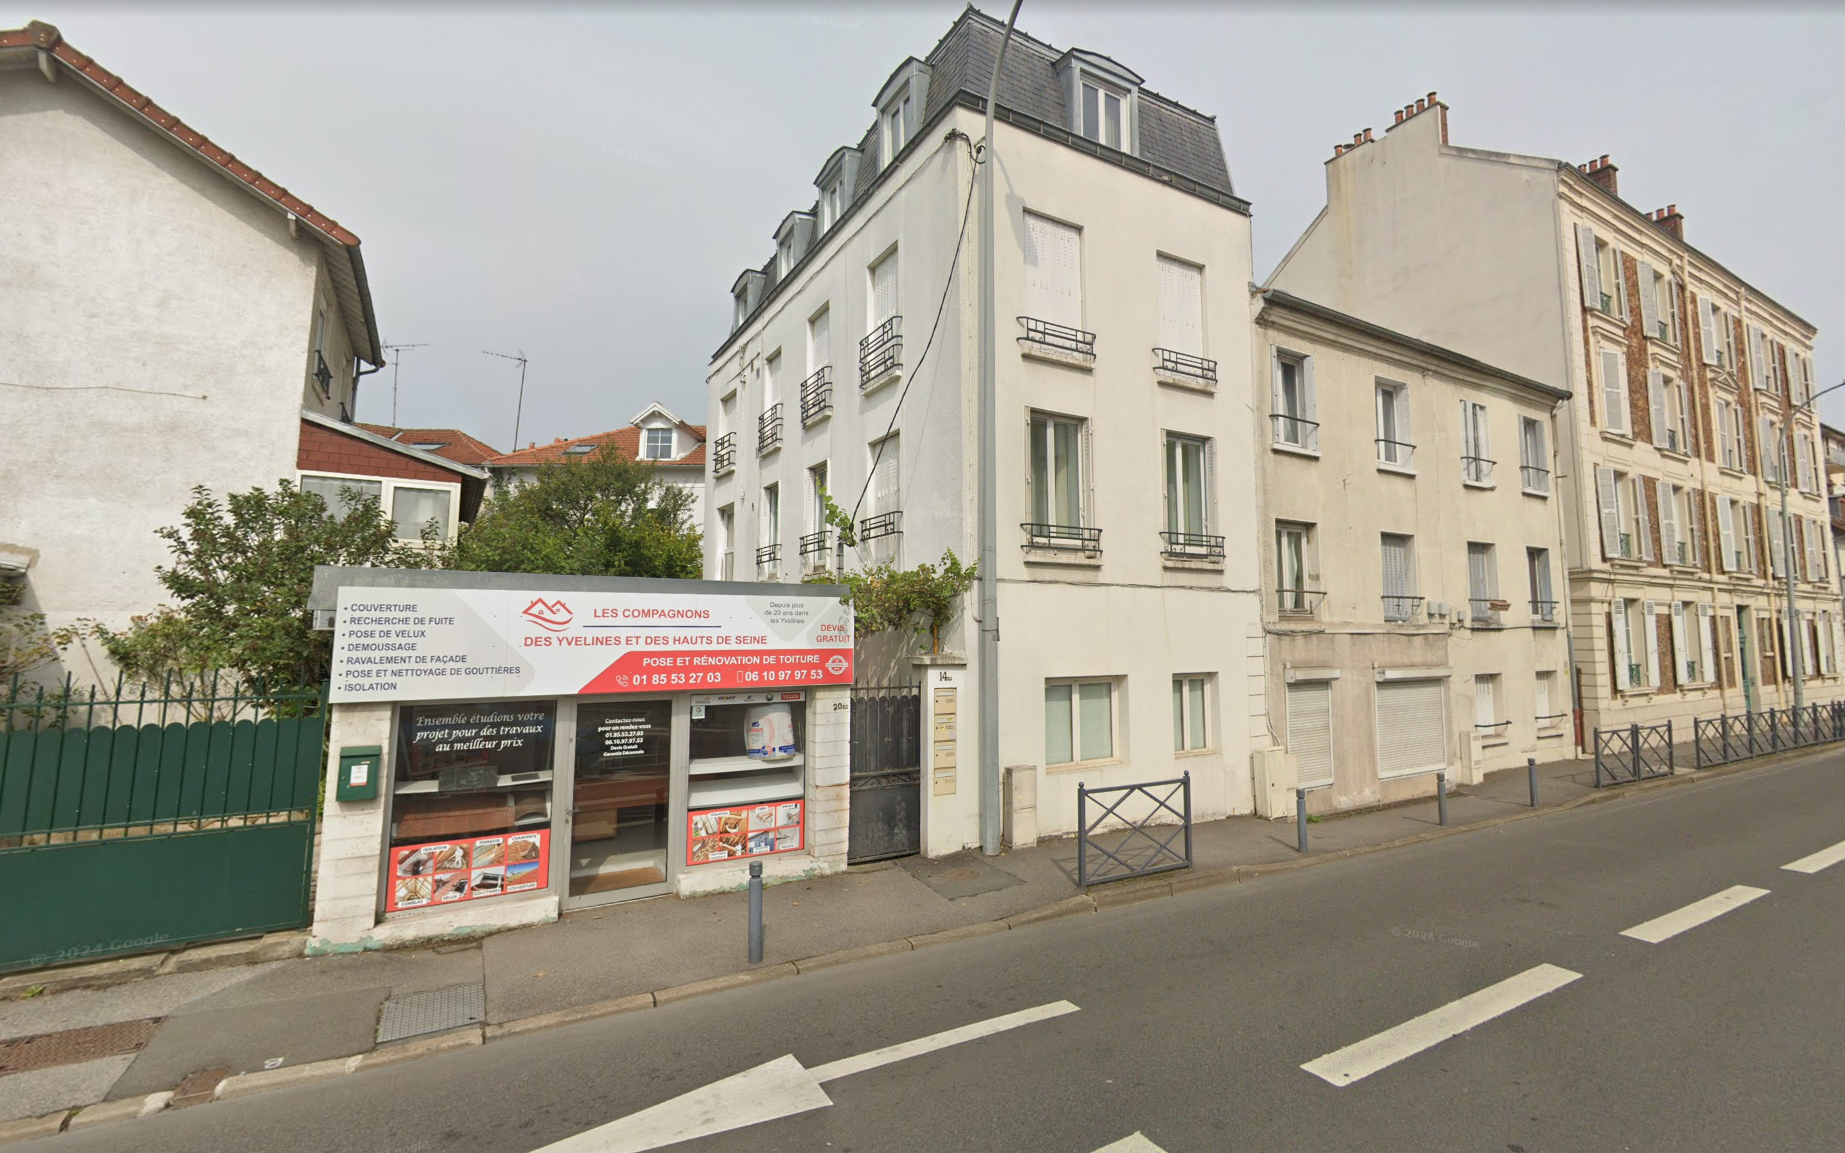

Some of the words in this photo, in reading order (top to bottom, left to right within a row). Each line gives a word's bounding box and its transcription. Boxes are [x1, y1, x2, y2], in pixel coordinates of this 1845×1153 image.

[350, 603, 418, 613] COUVERTURE
[593, 608, 619, 618] LES
[622, 608, 710, 619] COMPAGNONS
[349, 616, 412, 626] RECHERCHE
[413, 616, 426, 625] DE
[428, 616, 455, 625] FUITE
[820, 624, 845, 632] DEVIS
[348, 630, 377, 638] POSE
[379, 630, 392, 638] DE
[394, 630, 426, 638] VELUX
[816, 634, 851, 643] GRATUIT
[524, 636, 553, 647] DES
[556, 636, 622, 646] YVELINES
[626, 636, 642, 646] ET
[644, 636, 670, 646] DES
[673, 635, 713, 646] HAUTS
[716, 635, 732, 646] DE
[735, 635, 767, 645] SEINE
[347, 642, 418, 652] DEMOUSSAGE
[346, 656, 413, 665] RAVALEMENT
[414, 656, 428, 664] DE
[430, 654, 467, 665] FAÇADE
[642, 656, 674, 667] POSE
[676, 656, 692, 666] ET
[693, 654, 760, 666] RÉNOVATION
[762, 656, 776, 664] DE
[778, 654, 820, 664] TOITURE
[345, 670, 374, 679] POSE
[376, 670, 388, 678] ET
[390, 668, 448, 678] NETTOYAGE
[450, 668, 462, 676] DE
[464, 665, 521, 676] GOUTTIÈRES
[745, 670, 760, 682] 06
[762, 670, 775, 682] 10
[778, 669, 792, 681] 97
[794, 669, 808, 680] 97
[810, 668, 823, 680] 53
[632, 674, 648, 686] 01
[652, 673, 668, 685] 85
[670, 672, 686, 684] 53
[689, 672, 704, 684] 27
[706, 672, 722, 683] 03
[344, 682, 397, 692] ISOLATION
[416, 713, 467, 726] Ensemble
[470, 712, 514, 724] étudions
[518, 712, 544, 721] votre
[413, 728, 449, 743] projet
[449, 728, 478, 741] pour
[480, 724, 497, 736] des
[499, 724, 543, 735] travaux
[436, 743, 451, 752] au
[453, 738, 498, 750] meilleur
[497, 737, 524, 751] prix
